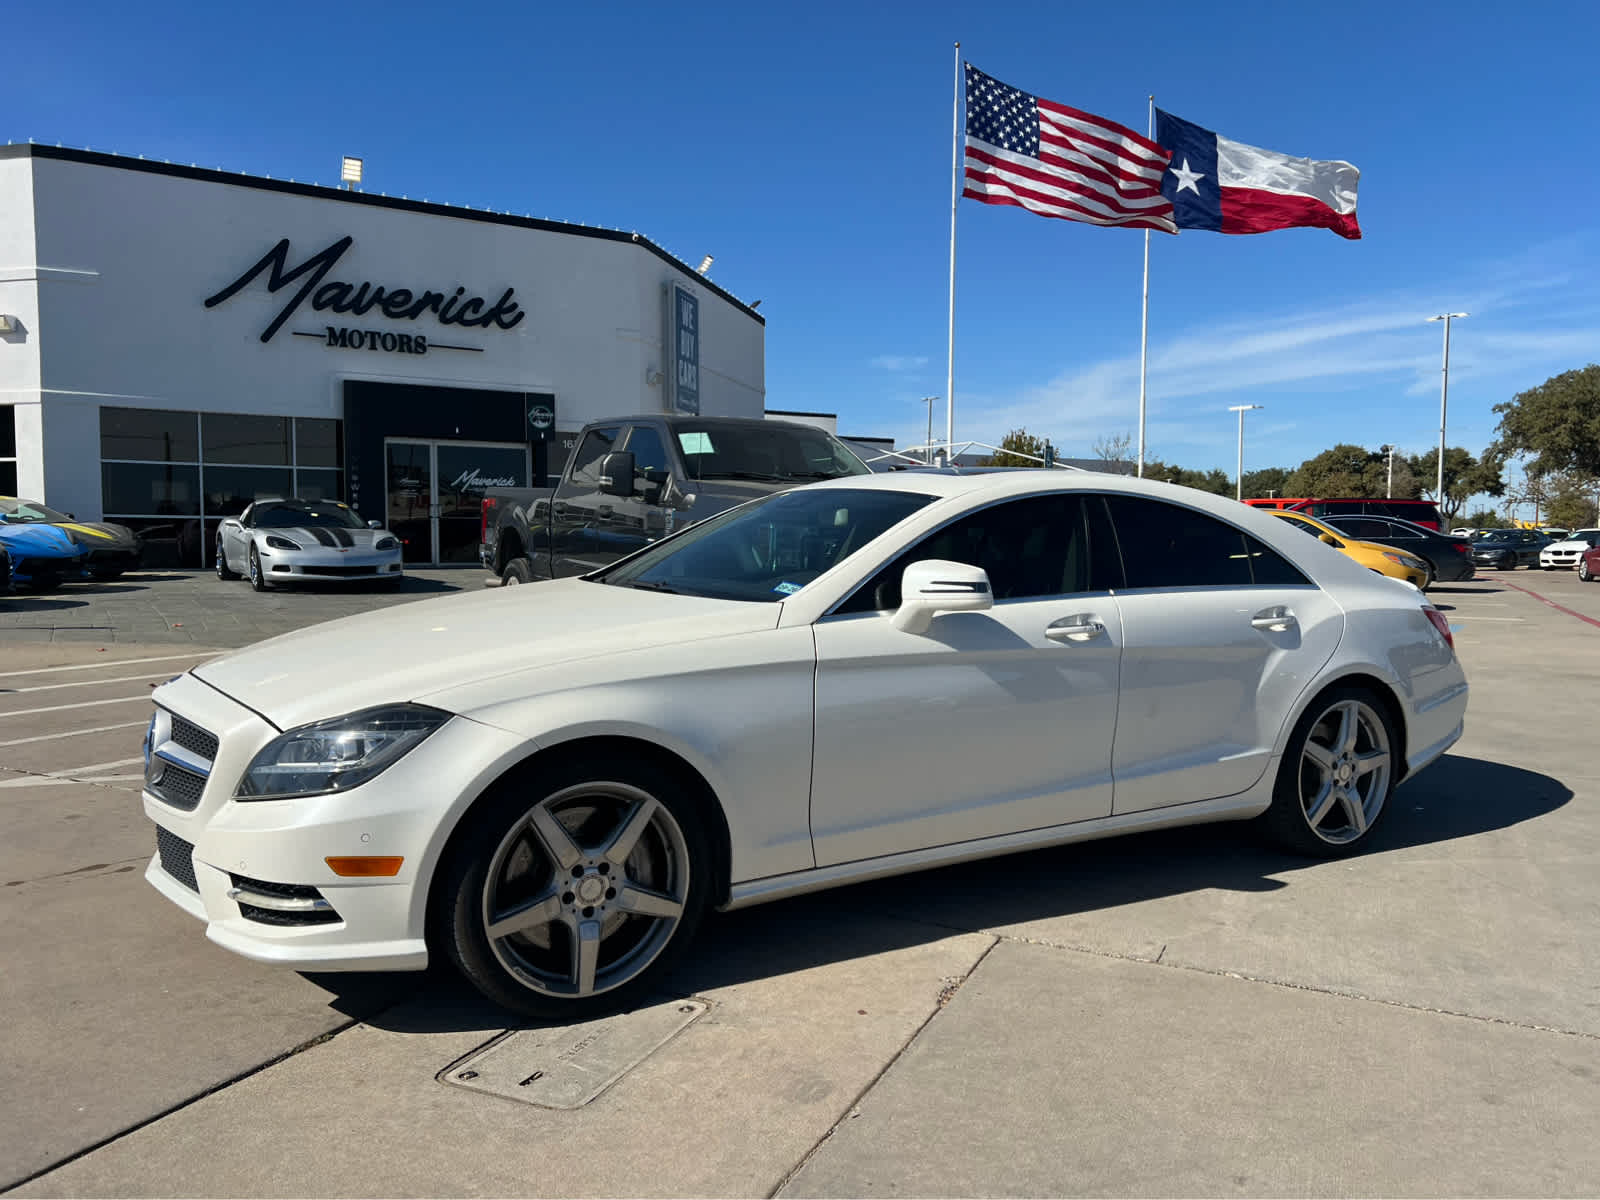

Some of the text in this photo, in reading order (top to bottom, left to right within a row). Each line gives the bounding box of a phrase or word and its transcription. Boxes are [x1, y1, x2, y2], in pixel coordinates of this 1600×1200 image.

[204, 235, 525, 343] Maverick
[681, 296, 695, 329] WE
[325, 327, 427, 355] MOTORS
[450, 468, 516, 493] Maverick
